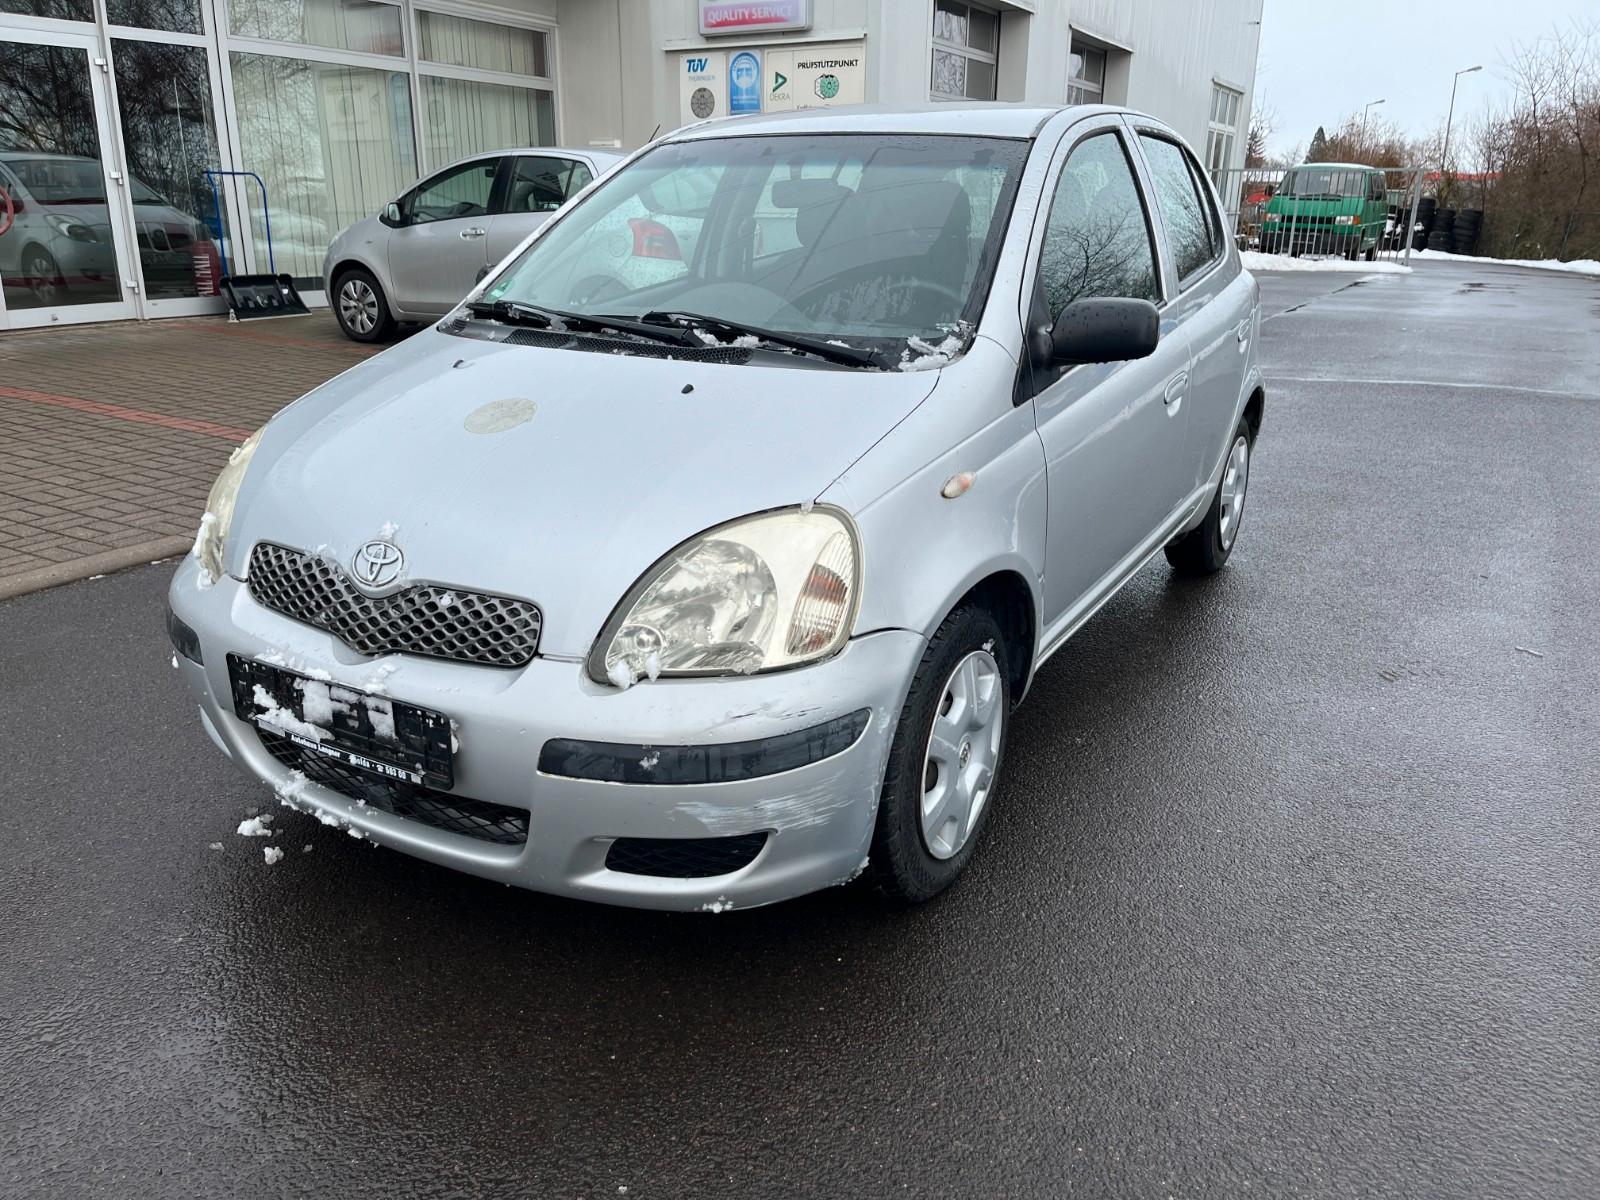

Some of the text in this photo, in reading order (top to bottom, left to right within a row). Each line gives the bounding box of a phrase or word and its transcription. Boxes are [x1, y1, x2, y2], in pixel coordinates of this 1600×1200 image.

[708, 4, 793, 25] QUALITY SERVICE
[686, 58, 708, 73] TÜV
[769, 92, 791, 101] DEKRA
